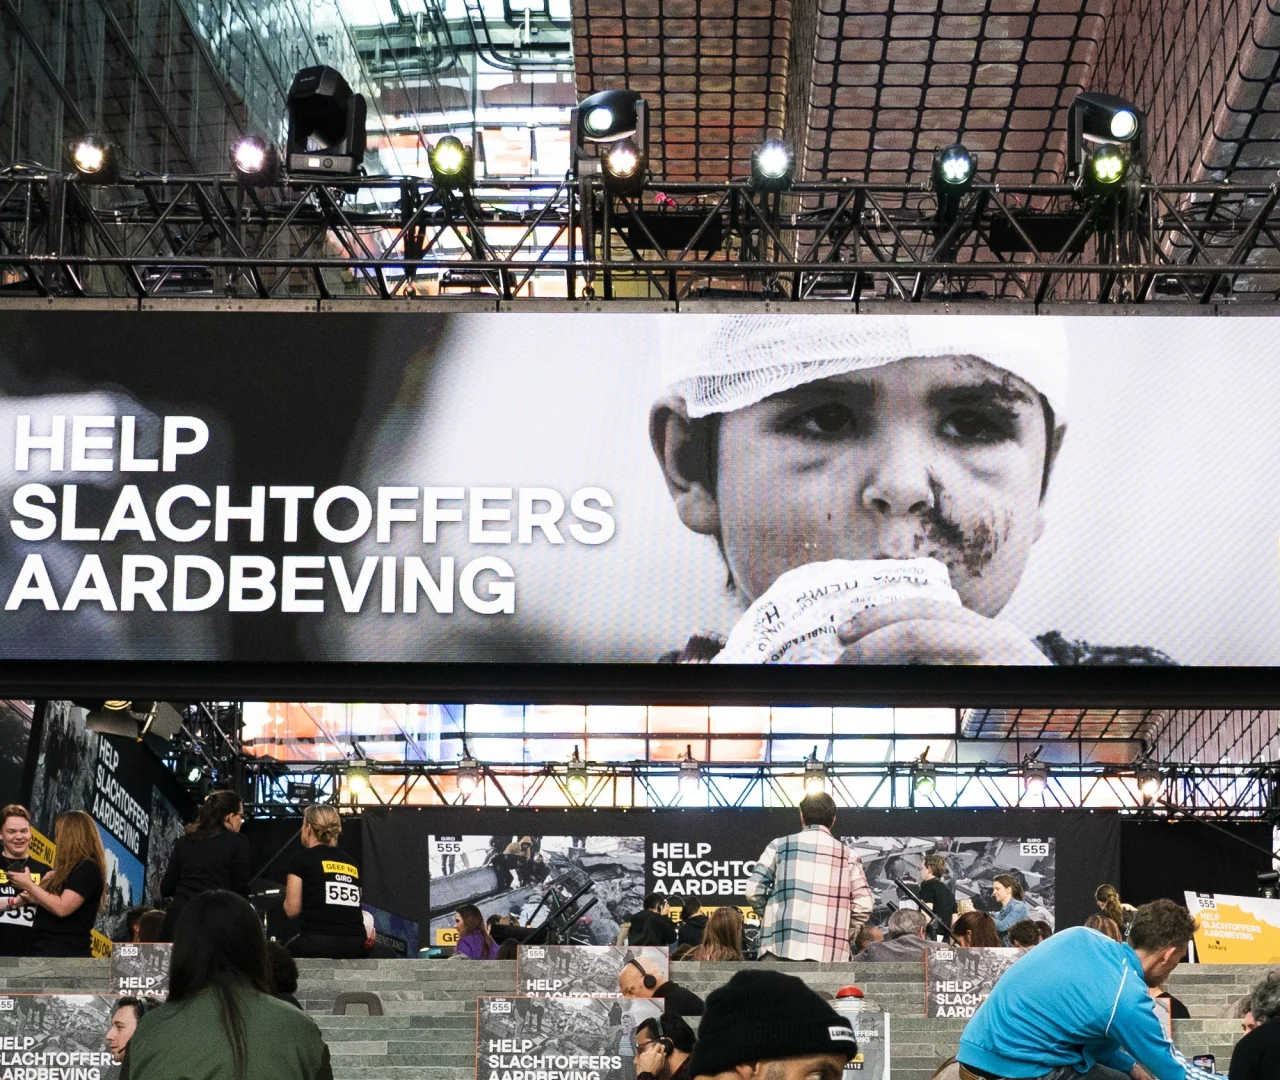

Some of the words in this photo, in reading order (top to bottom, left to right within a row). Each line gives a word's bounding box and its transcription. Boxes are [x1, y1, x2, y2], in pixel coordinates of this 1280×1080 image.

[15, 415, 209, 472] HELP
[10, 484, 616, 545] SLACHTOFFERS
[5, 555, 515, 615] AARDBEVING
[99, 736, 119, 772] HELP
[96, 765, 149, 835] SLACHTOFFERS
[92, 793, 139, 855] AARDBEVING
[45, 846, 53, 864] NU
[437, 843, 461, 852] 555
[652, 843, 711, 859] HELP
[1022, 844, 1047, 854] 555
[326, 863, 346, 872] GEEF
[347, 866, 357, 876] NU
[652, 861, 756, 877] SLACHTO
[335, 874, 352, 883] GIRO
[329, 886, 359, 902] 555
[652, 880, 747, 896] AARDBE
[1198, 899, 1216, 908] 555
[120, 977, 155, 989] HELP
[526, 979, 563, 991] HELP
[936, 981, 972, 993] HELP
[492, 1003, 510, 1012] 555
[489, 1039, 533, 1053] HELP
[488, 1055, 622, 1069] SLACHTOFFERS
